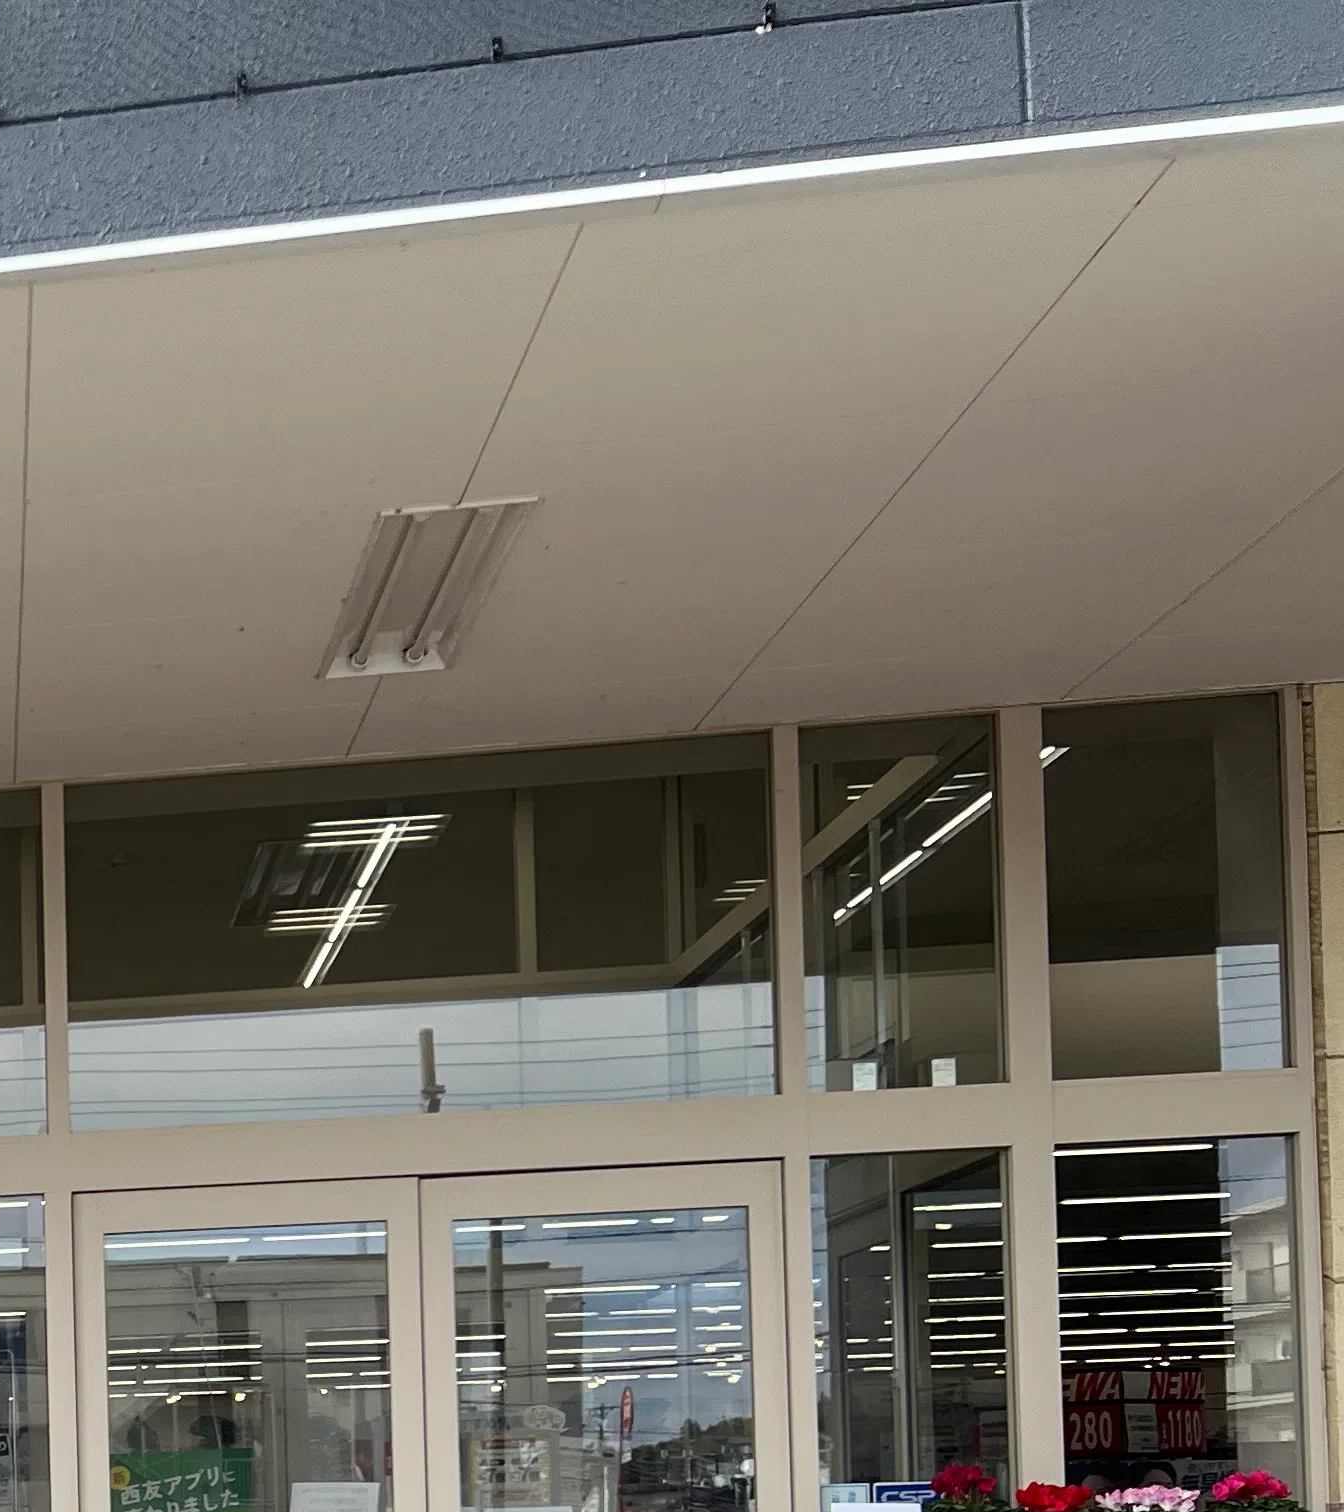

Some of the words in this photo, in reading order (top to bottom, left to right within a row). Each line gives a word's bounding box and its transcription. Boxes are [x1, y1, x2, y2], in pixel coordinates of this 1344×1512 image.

[1070, 1411, 1112, 1450] 280
[121, 1467, 236, 1505] 西友アプリに
